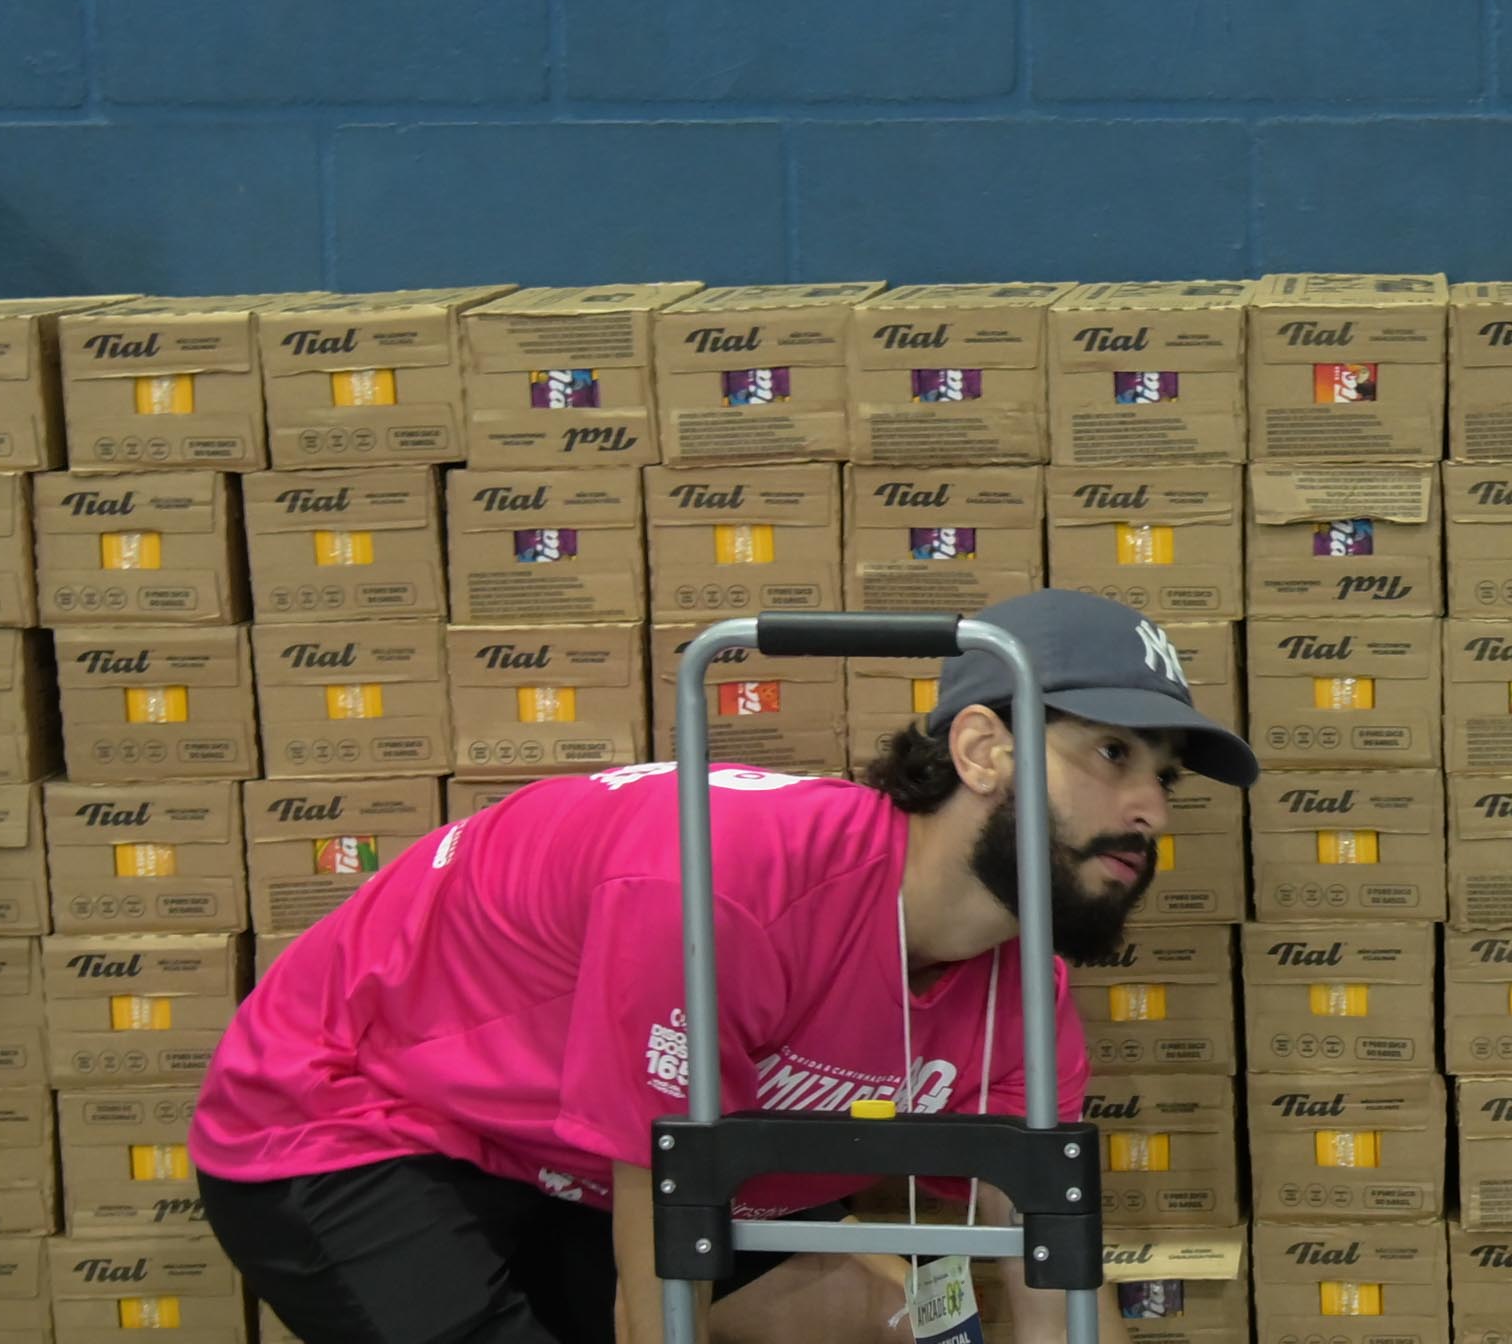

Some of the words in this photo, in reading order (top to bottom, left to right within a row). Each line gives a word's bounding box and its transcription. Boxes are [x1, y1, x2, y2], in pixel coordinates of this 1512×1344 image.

[83, 333, 160, 358] Tial
[281, 329, 357, 355] Tial
[685, 327, 761, 352] Tial
[873, 324, 948, 348] Tial
[1074, 327, 1148, 351] Tial
[1277, 322, 1353, 346] Tial
[562, 427, 637, 452] Tial
[61, 492, 135, 515] Tial
[275, 488, 350, 513] Tial
[473, 486, 547, 511] Tial
[670, 484, 744, 508] Tial
[874, 483, 949, 507] Tial
[1074, 484, 1149, 508] Tial
[1336, 576, 1412, 600] Tial
[281, 643, 356, 667] Tial
[475, 645, 551, 668] Tial
[1278, 636, 1352, 659] Tial
[76, 650, 150, 673] Tial
[267, 796, 344, 821] Tial
[1279, 790, 1354, 813] Tial
[75, 802, 150, 826] Tial
[66, 954, 141, 977] Tial
[1268, 942, 1342, 966] Tial
[1286, 1242, 1360, 1264] Tial
[74, 1259, 147, 1282] Tial
